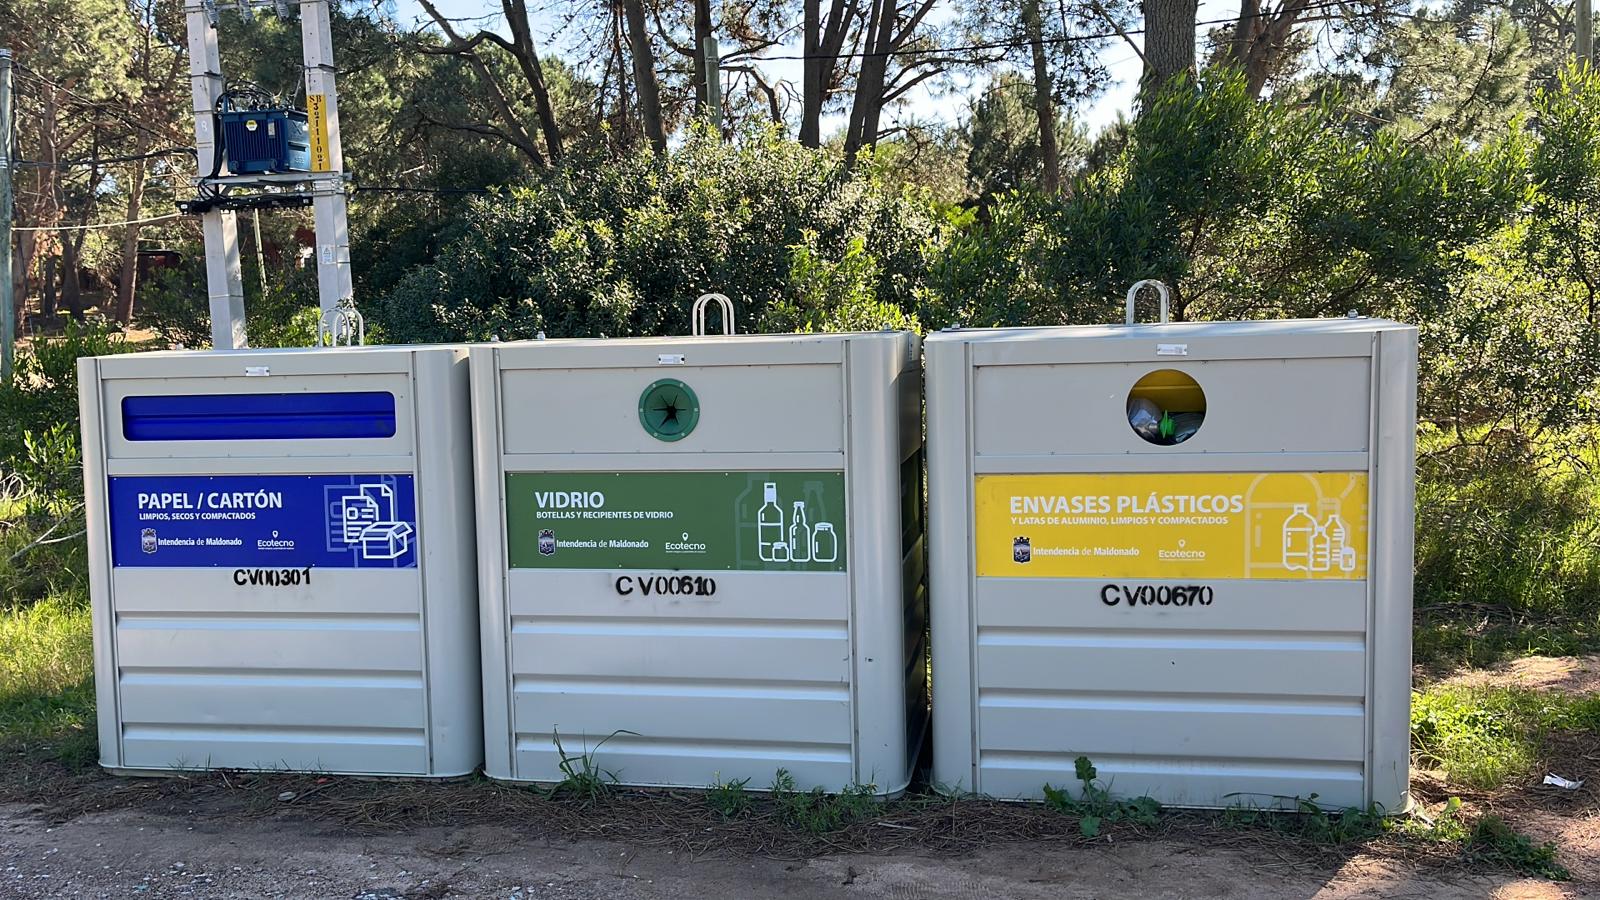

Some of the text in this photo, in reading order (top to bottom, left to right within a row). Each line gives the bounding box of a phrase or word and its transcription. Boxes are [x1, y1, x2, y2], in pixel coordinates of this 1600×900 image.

[309, 95, 322, 103] SB
[138, 489, 282, 510] PAPEL / CARTÓN
[535, 491, 605, 509] VIDRIO
[1010, 492, 1244, 514] ENVASES PLÁSTICOS
[139, 513, 171, 521] LIMPIOS,
[201, 512, 256, 520] COMPACTADOS
[536, 511, 576, 519] BOTELLAS
[583, 511, 633, 519] RECIPIENTES
[633, 511, 644, 519] DE
[645, 511, 674, 519] VIDRIO
[1018, 516, 1046, 525] LATAS
[1047, 516, 1060, 525] DE
[1061, 516, 1110, 526] ALUMINIO,
[1110, 516, 1149, 525] LIMPIOS
[1149, 516, 1157, 525] Y
[1158, 516, 1229, 525] COMPACTADOS
[158, 538, 243, 546] Intendencia de Maldonado
[257, 539, 295, 547] Ecotecno
[556, 539, 649, 548] Intendencia de Maldonado
[665, 541, 706, 550] Ecotecno
[1033, 547, 1140, 556] Intendencia de Maldonado
[1158, 549, 1206, 558] Ecotecno
[233, 568, 312, 587] CV00301
